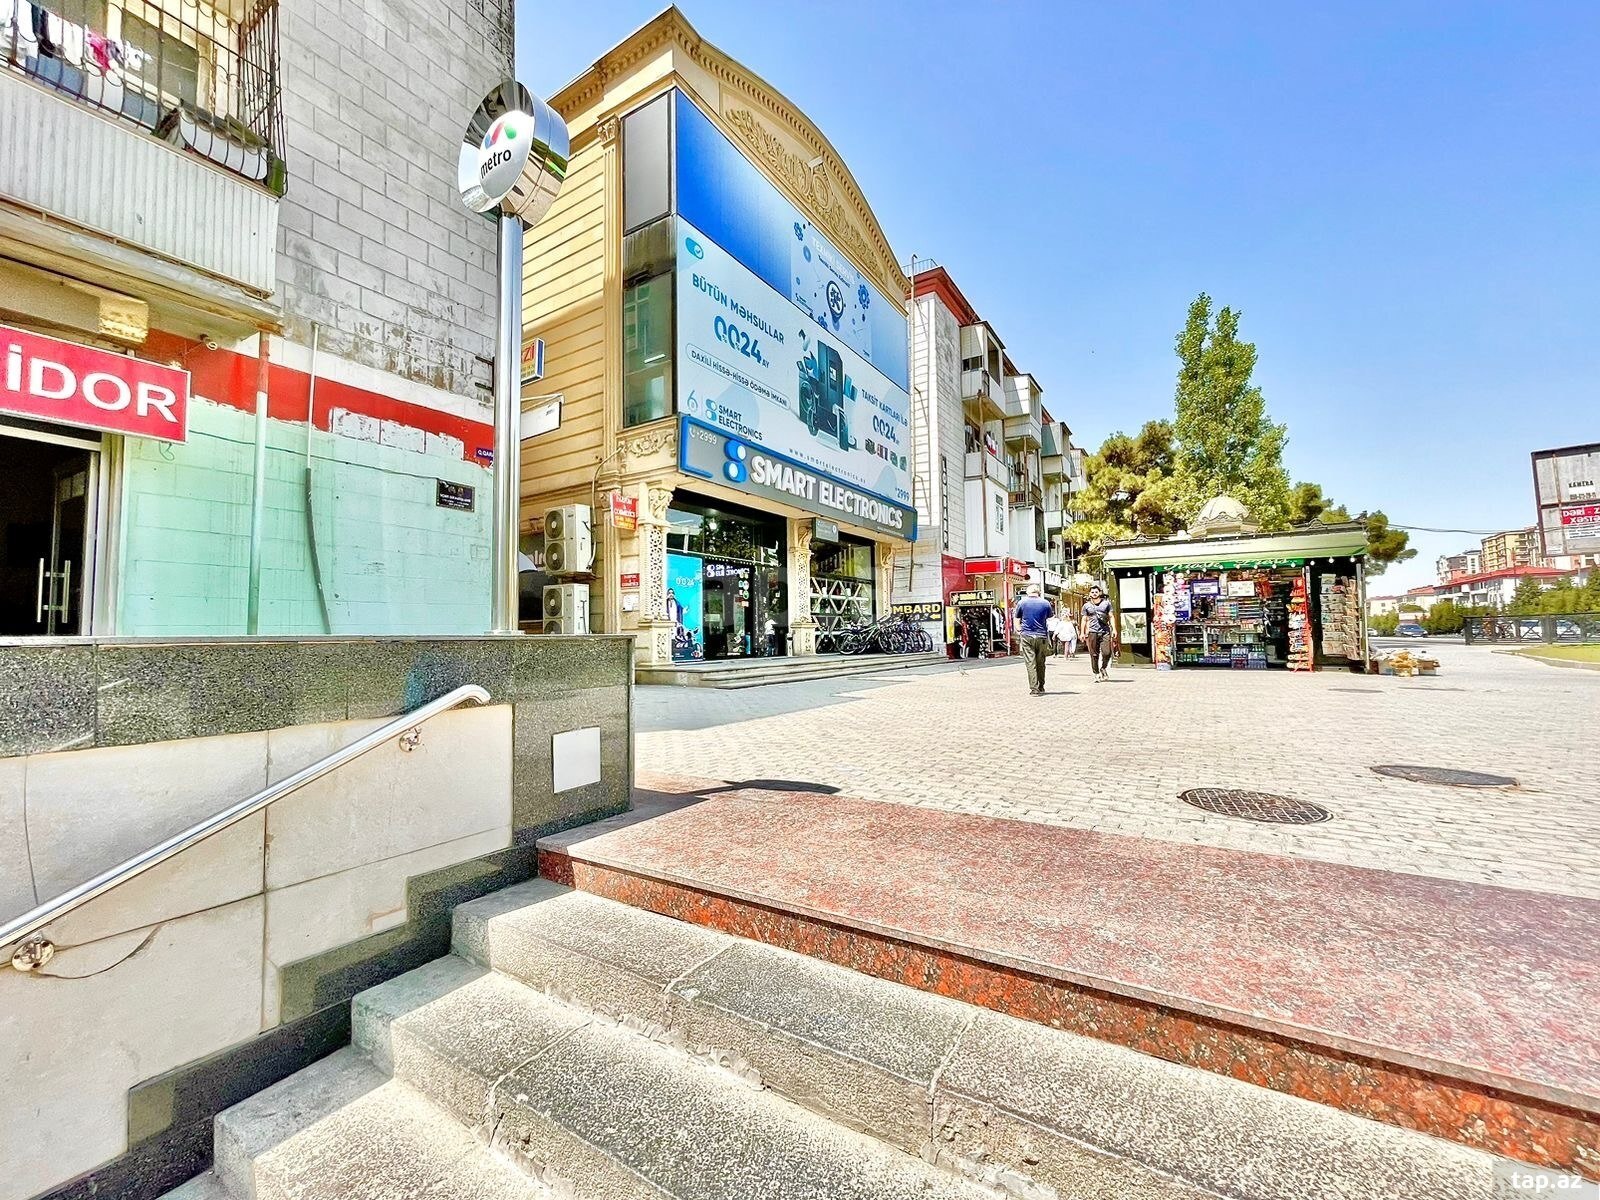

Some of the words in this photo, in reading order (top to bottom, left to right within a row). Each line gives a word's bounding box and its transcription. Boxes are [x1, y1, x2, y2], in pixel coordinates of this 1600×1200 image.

[480, 149, 512, 179] metro
[692, 272, 728, 307] BÜTÜN
[730, 299, 785, 345] MƏHSULLAR
[691, 350, 712, 367] DAXİLİ
[750, 381, 770, 398] ÖDƏMƏ
[762, 359, 770, 368] AY
[6, 343, 179, 423] İDOR
[861, 389, 879, 407] TAKSİT
[718, 405, 742, 422] SMART
[718, 415, 763, 441] ELECTRONICS
[750, 455, 817, 499] SMART
[819, 480, 903, 529] ELECTRONICS
[892, 603, 941, 615] MBARD
